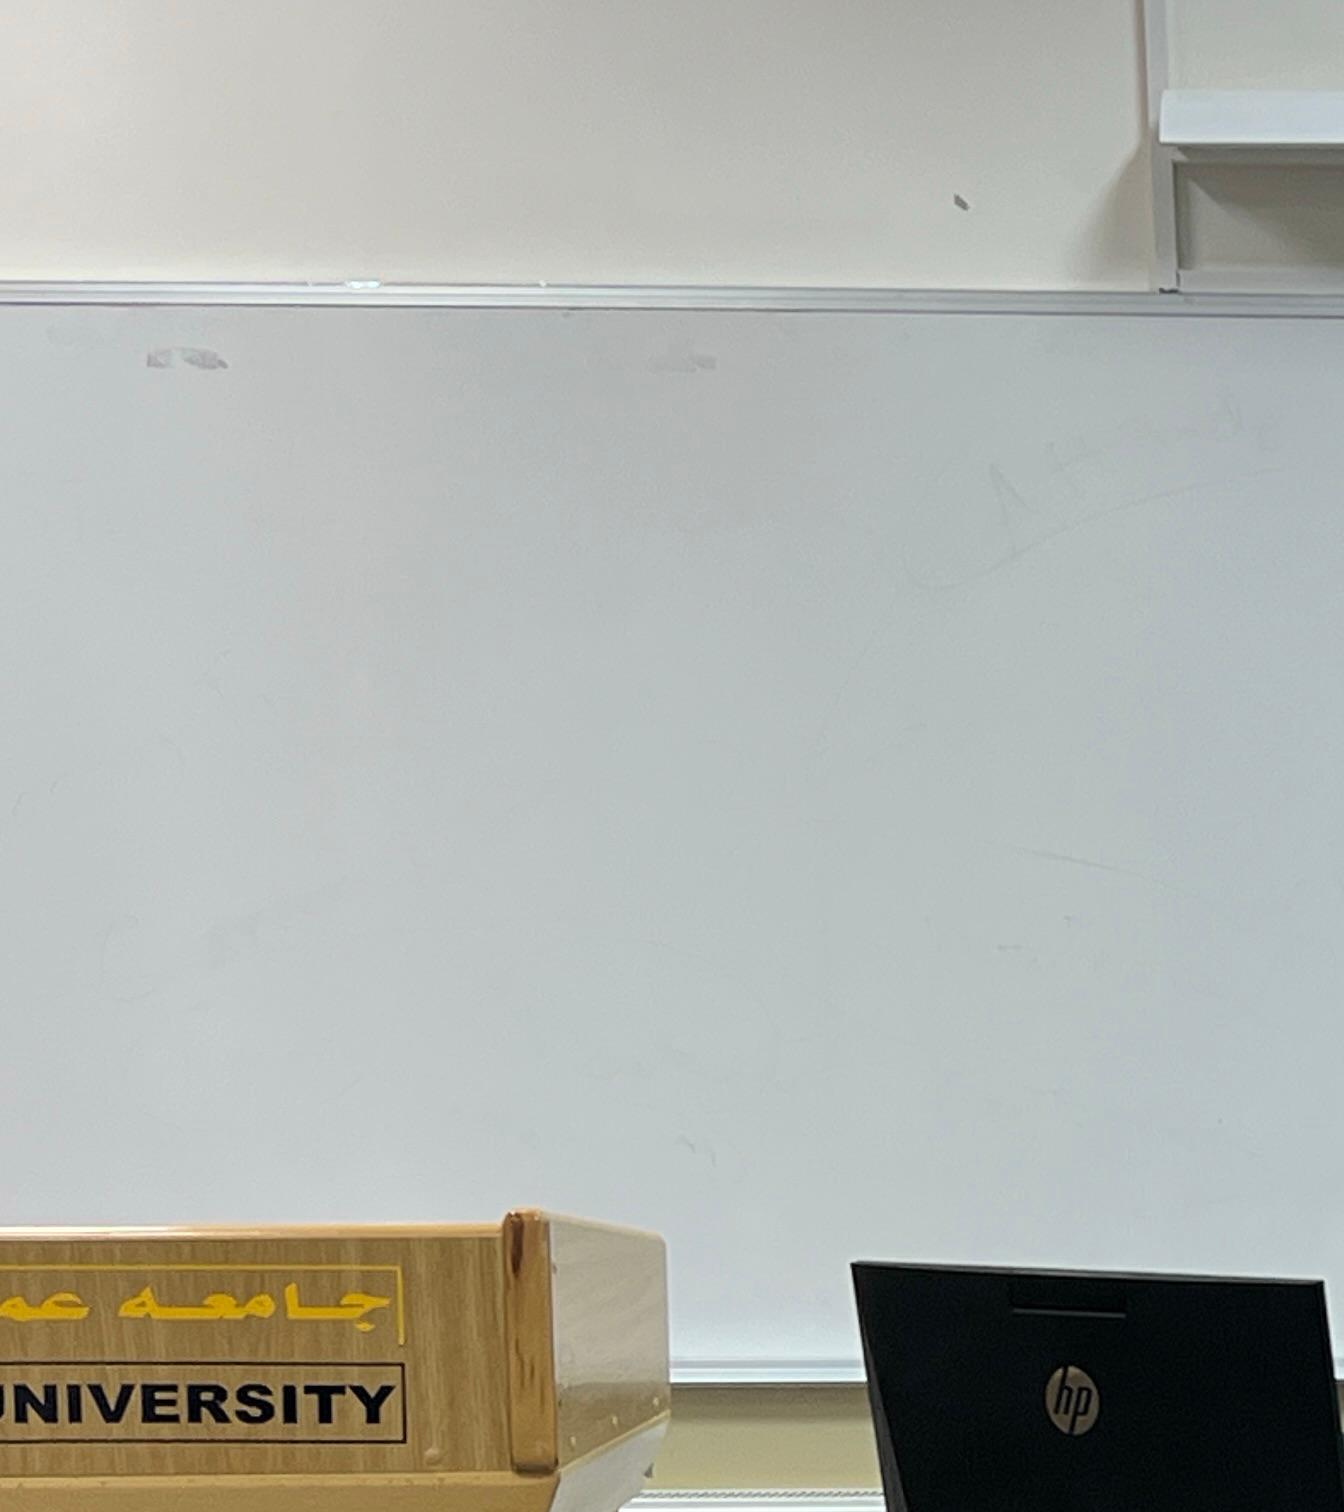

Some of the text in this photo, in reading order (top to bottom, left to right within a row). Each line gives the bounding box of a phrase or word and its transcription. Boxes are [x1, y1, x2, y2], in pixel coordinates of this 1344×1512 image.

[0, 1292, 92, 1323] عم
[0, 1383, 397, 1425] NIVERSITY
[1050, 1365, 1095, 1435] hp
